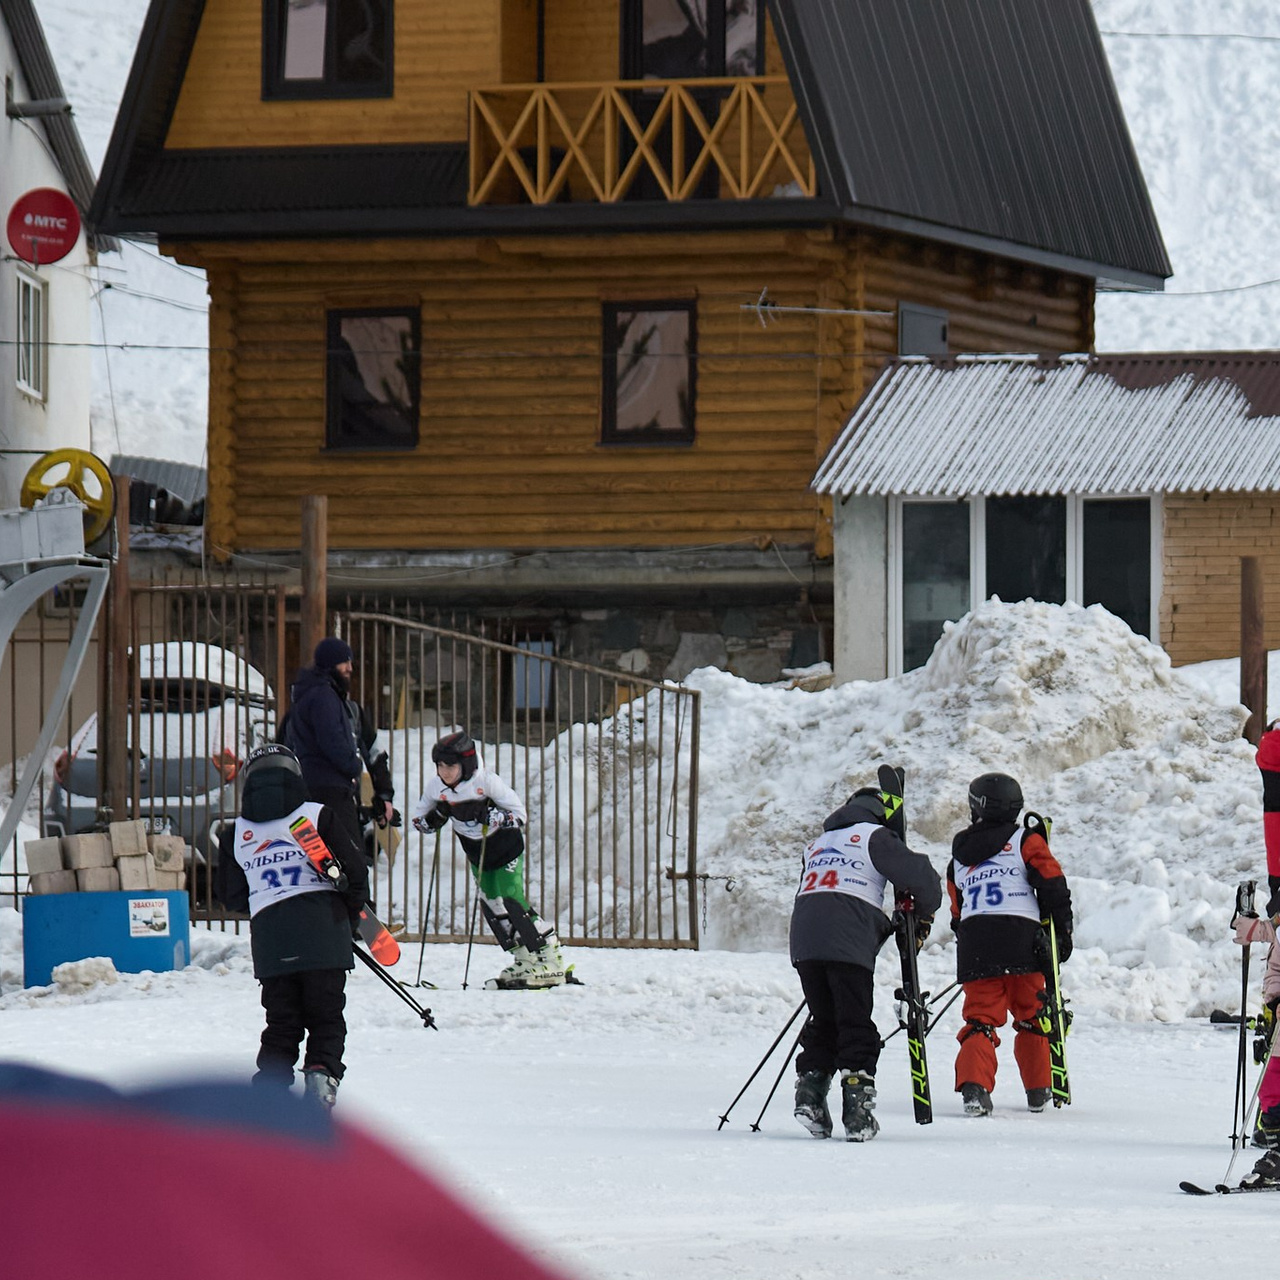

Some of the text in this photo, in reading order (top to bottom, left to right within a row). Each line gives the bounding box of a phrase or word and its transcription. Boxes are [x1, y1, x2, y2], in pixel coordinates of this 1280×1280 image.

[34, 214, 67, 230] МТС
[802, 869, 839, 893] 24
[960, 867, 1020, 891] ЭЛЬБРУС
[968, 881, 1004, 911] 75
[534, 971, 565, 980] HEAD
